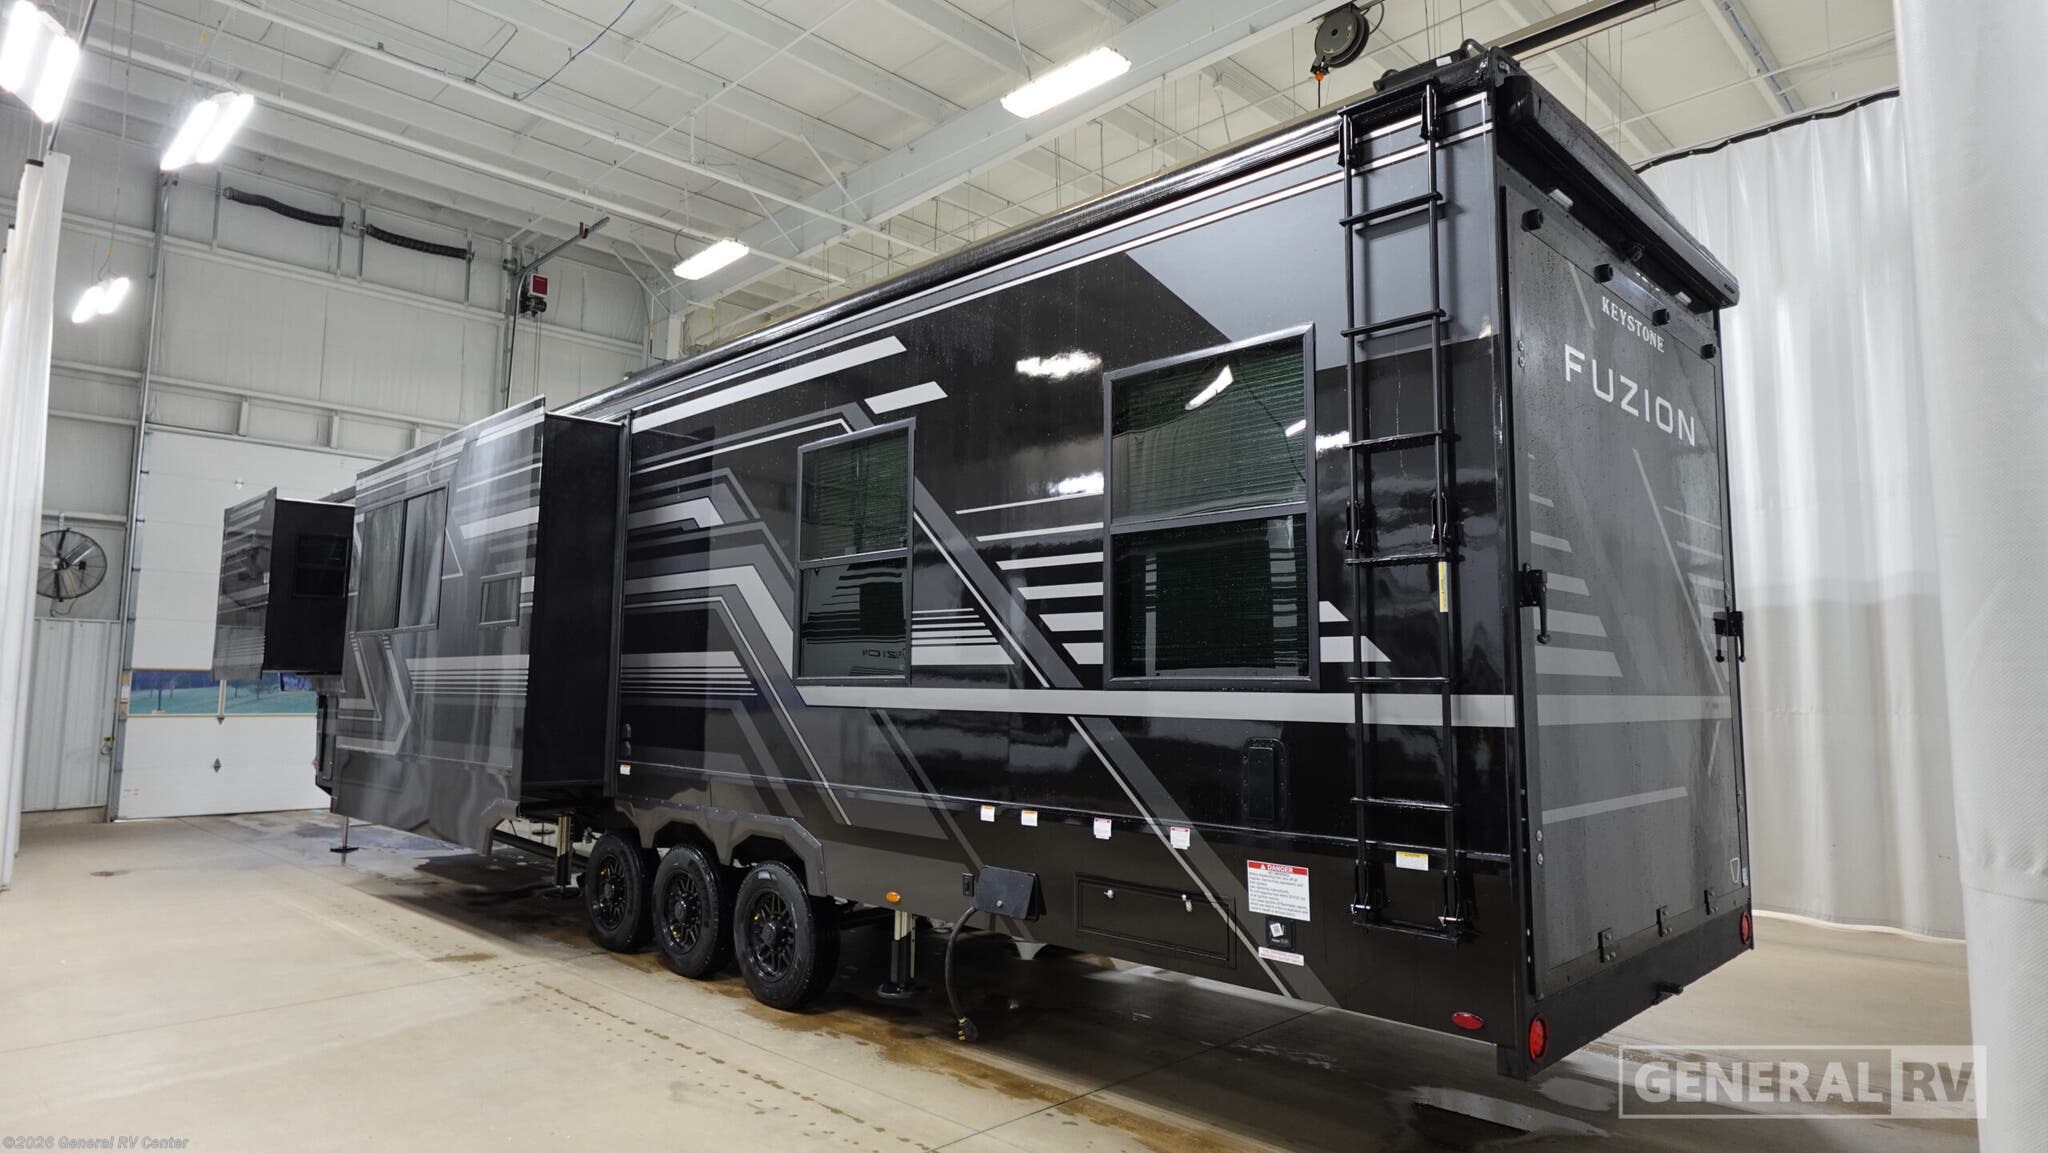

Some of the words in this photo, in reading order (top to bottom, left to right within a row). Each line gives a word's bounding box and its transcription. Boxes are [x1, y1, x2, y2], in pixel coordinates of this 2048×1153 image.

[1602, 296, 1665, 353] KEYSTONE
[1564, 343, 1695, 447] FUZION
[1267, 863, 1294, 873] DANGER
